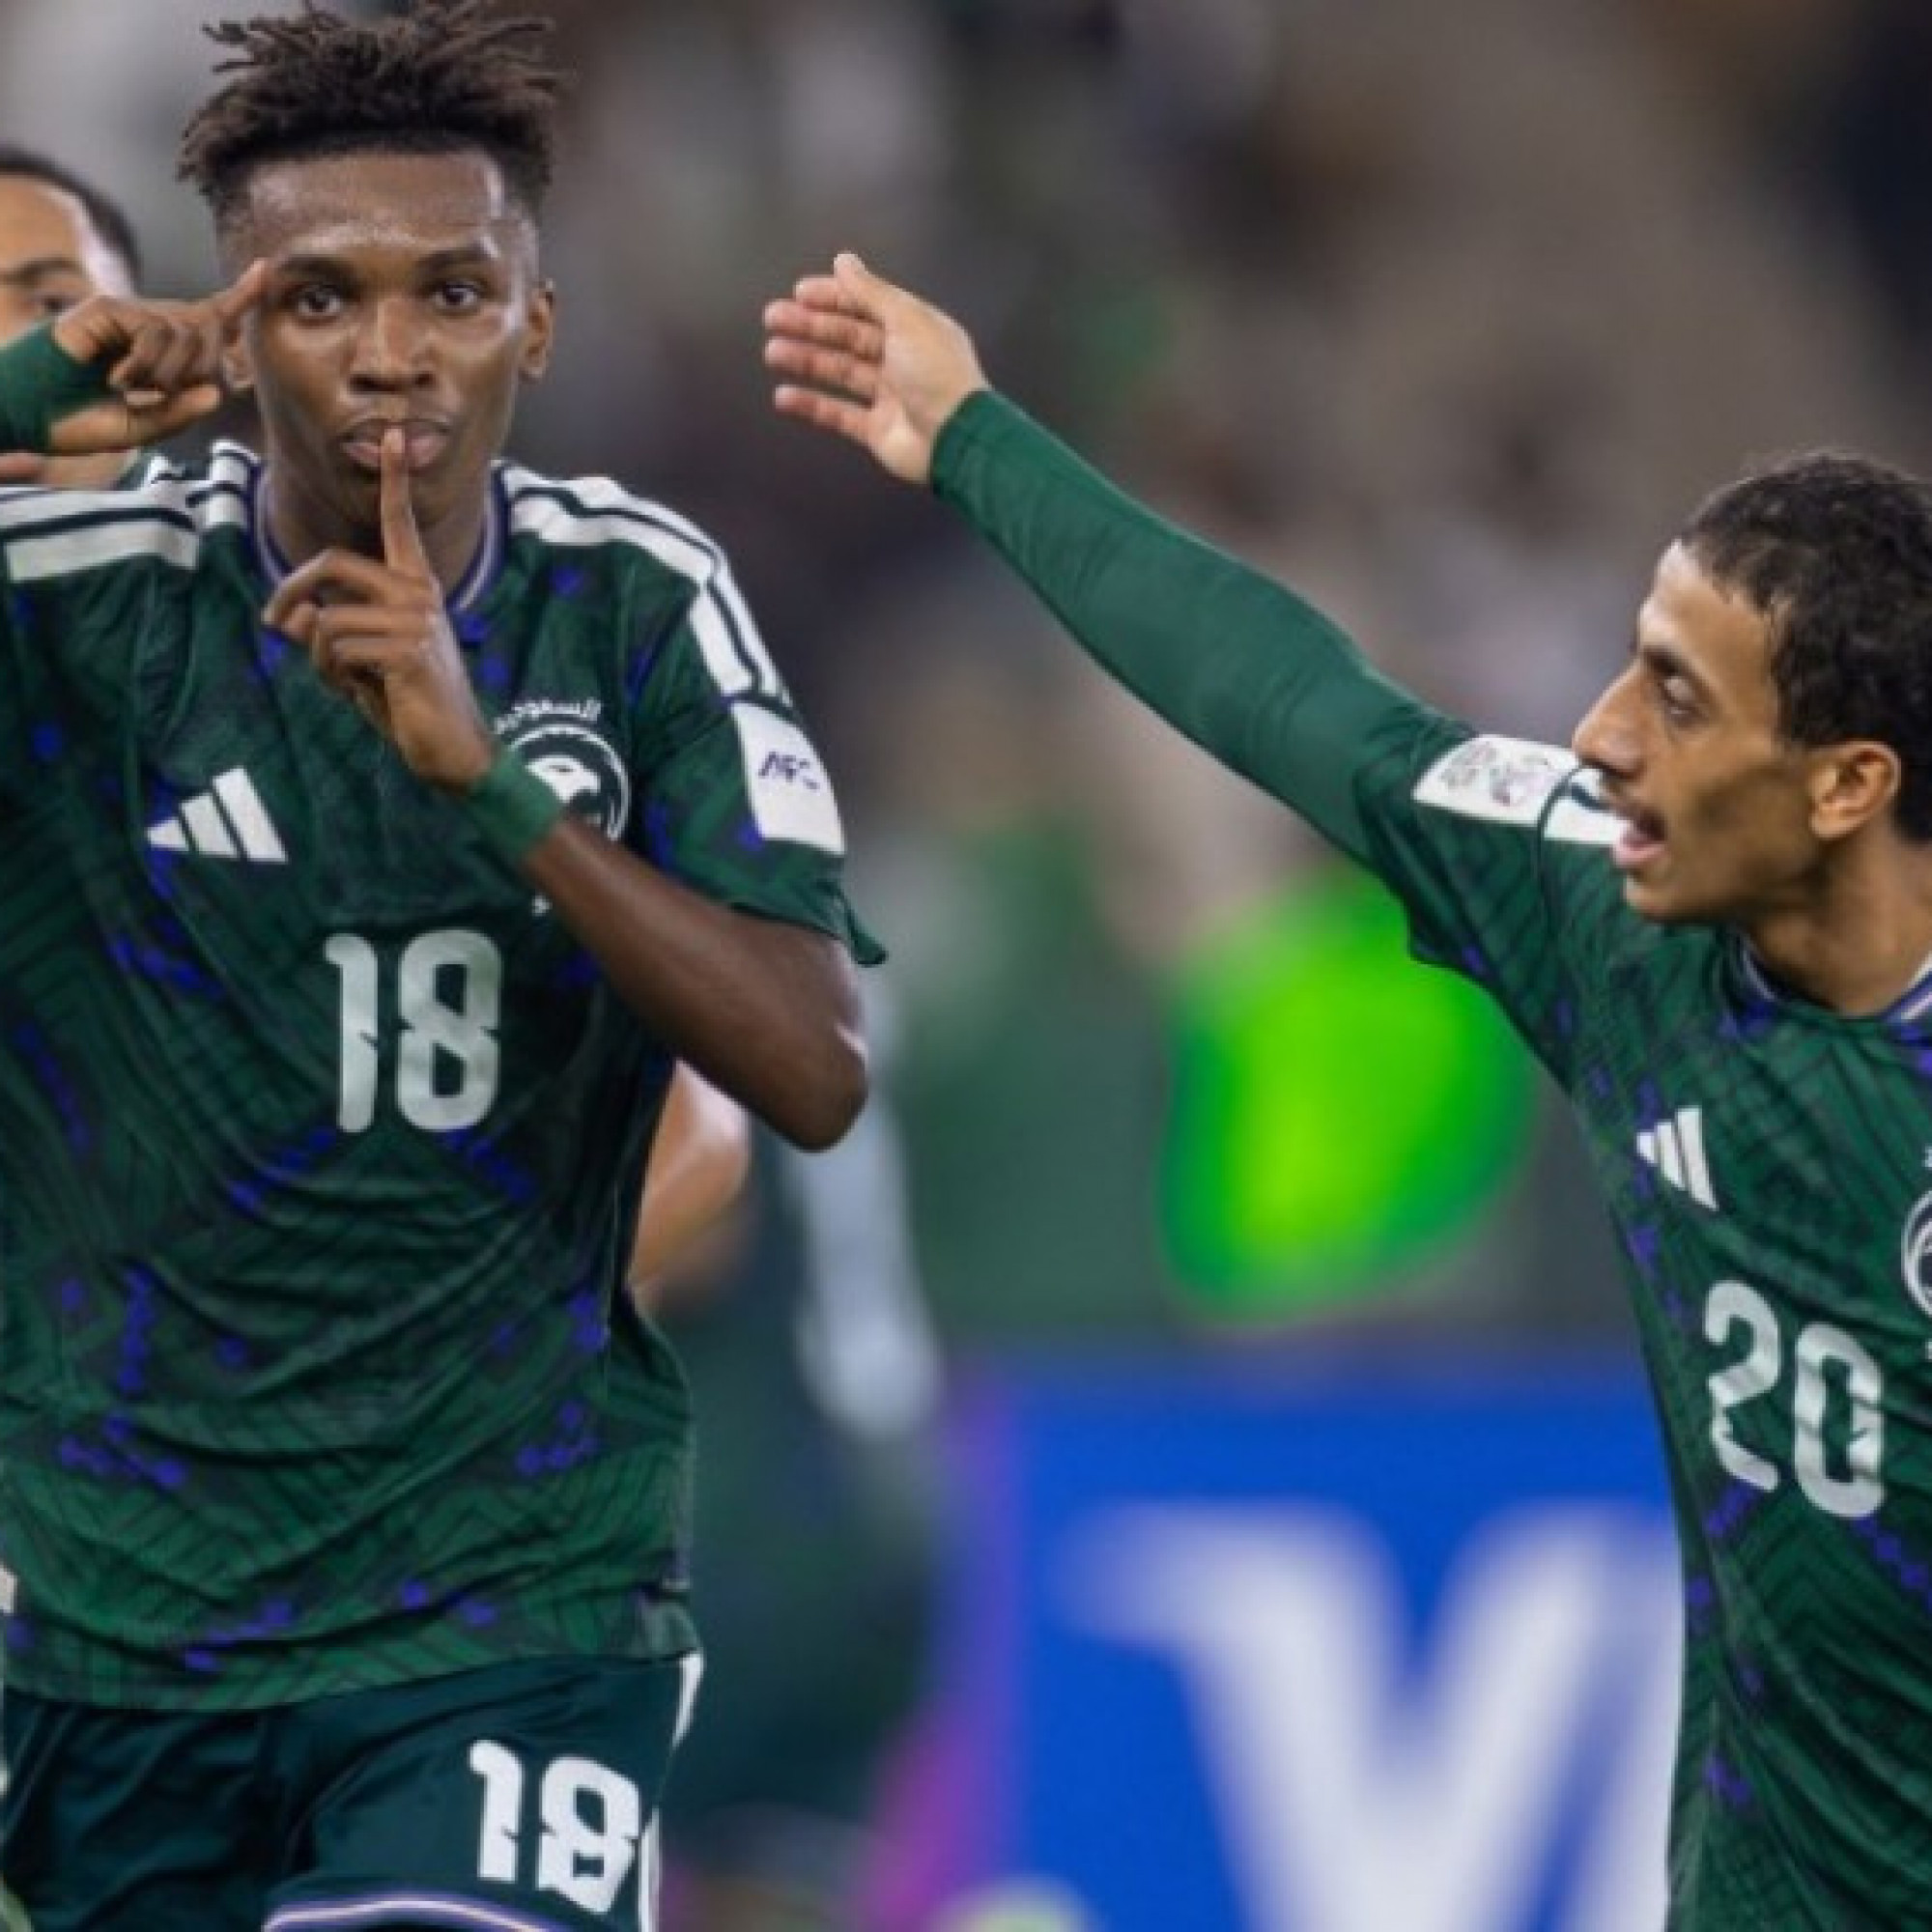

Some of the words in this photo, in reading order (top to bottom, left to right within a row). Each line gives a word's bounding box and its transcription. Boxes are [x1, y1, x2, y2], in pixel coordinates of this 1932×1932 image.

[323, 928, 502, 1133] 18
[1704, 1279, 1885, 1518] 20
[469, 1740, 639, 1915] 18
